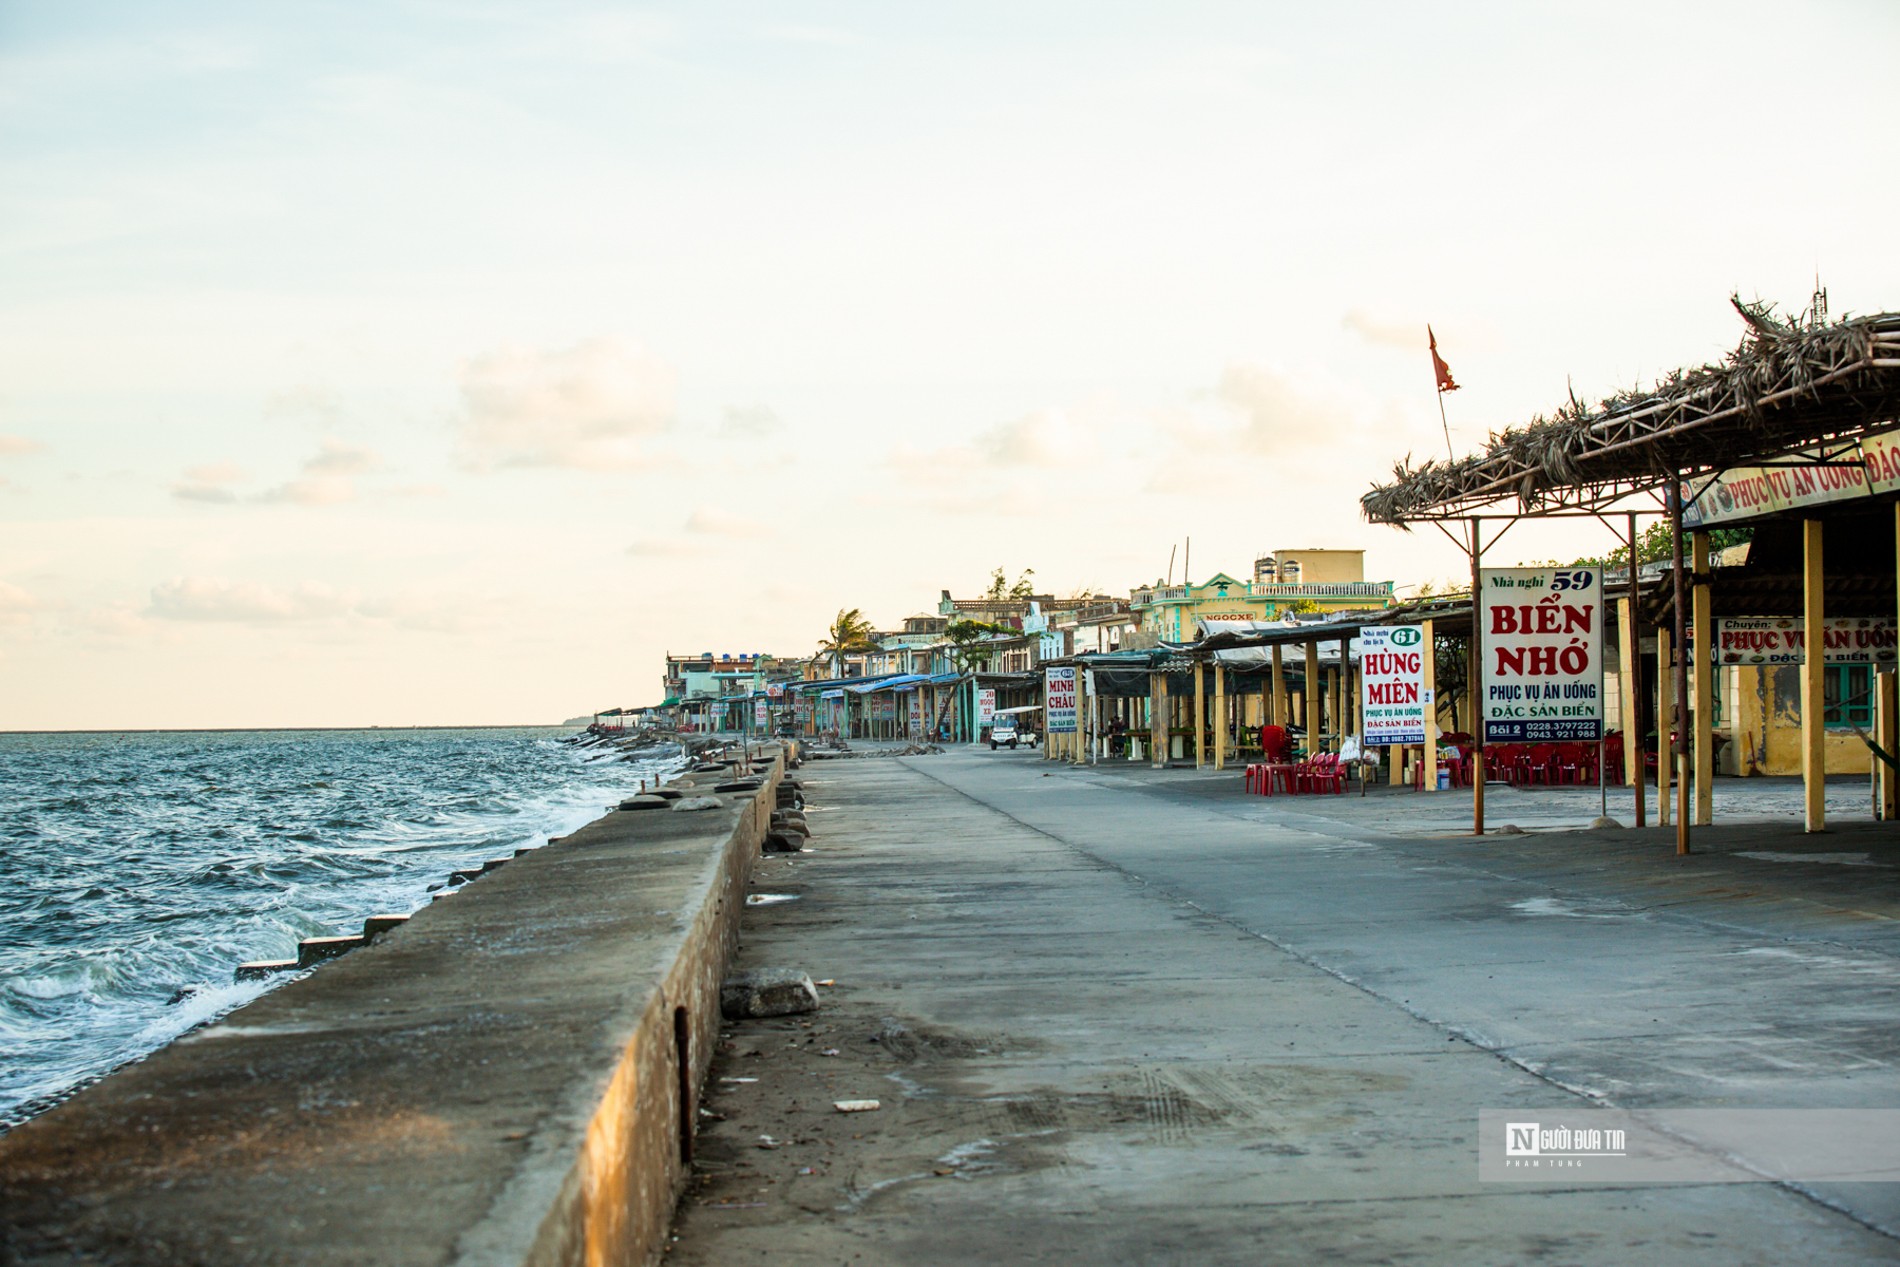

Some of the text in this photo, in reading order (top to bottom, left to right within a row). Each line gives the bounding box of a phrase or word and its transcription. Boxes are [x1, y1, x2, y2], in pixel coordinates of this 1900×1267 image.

[1730, 477, 1769, 512] PHỤC
[1765, 470, 1793, 506] VỤ
[1490, 576, 1515, 588] Nhà
[1550, 570, 1593, 591] 59
[1489, 592, 1595, 635] BIỂN
[1725, 620, 1772, 630] Chuyên:
[1394, 629, 1418, 645] 61
[1721, 631, 1780, 653] PHỤC
[1365, 647, 1421, 676] HÙNG
[1494, 637, 1589, 677] NHỚ
[1049, 679, 1075, 693] MINH
[1368, 676, 1419, 706] MIÊN
[1490, 679, 1596, 703] PHỤC VỤ ĂN UỐNG
[1048, 693, 1076, 709] CHÂU
[1491, 700, 1595, 719] ĐẶC SẢN BIỂN
[1366, 708, 1383, 718] PHỤC
[1405, 705, 1422, 717] UỐNG
[1513, 725, 1521, 734] 2
[1526, 721, 1596, 731] 0228.3797222
[1577, 730, 1596, 738] 988
